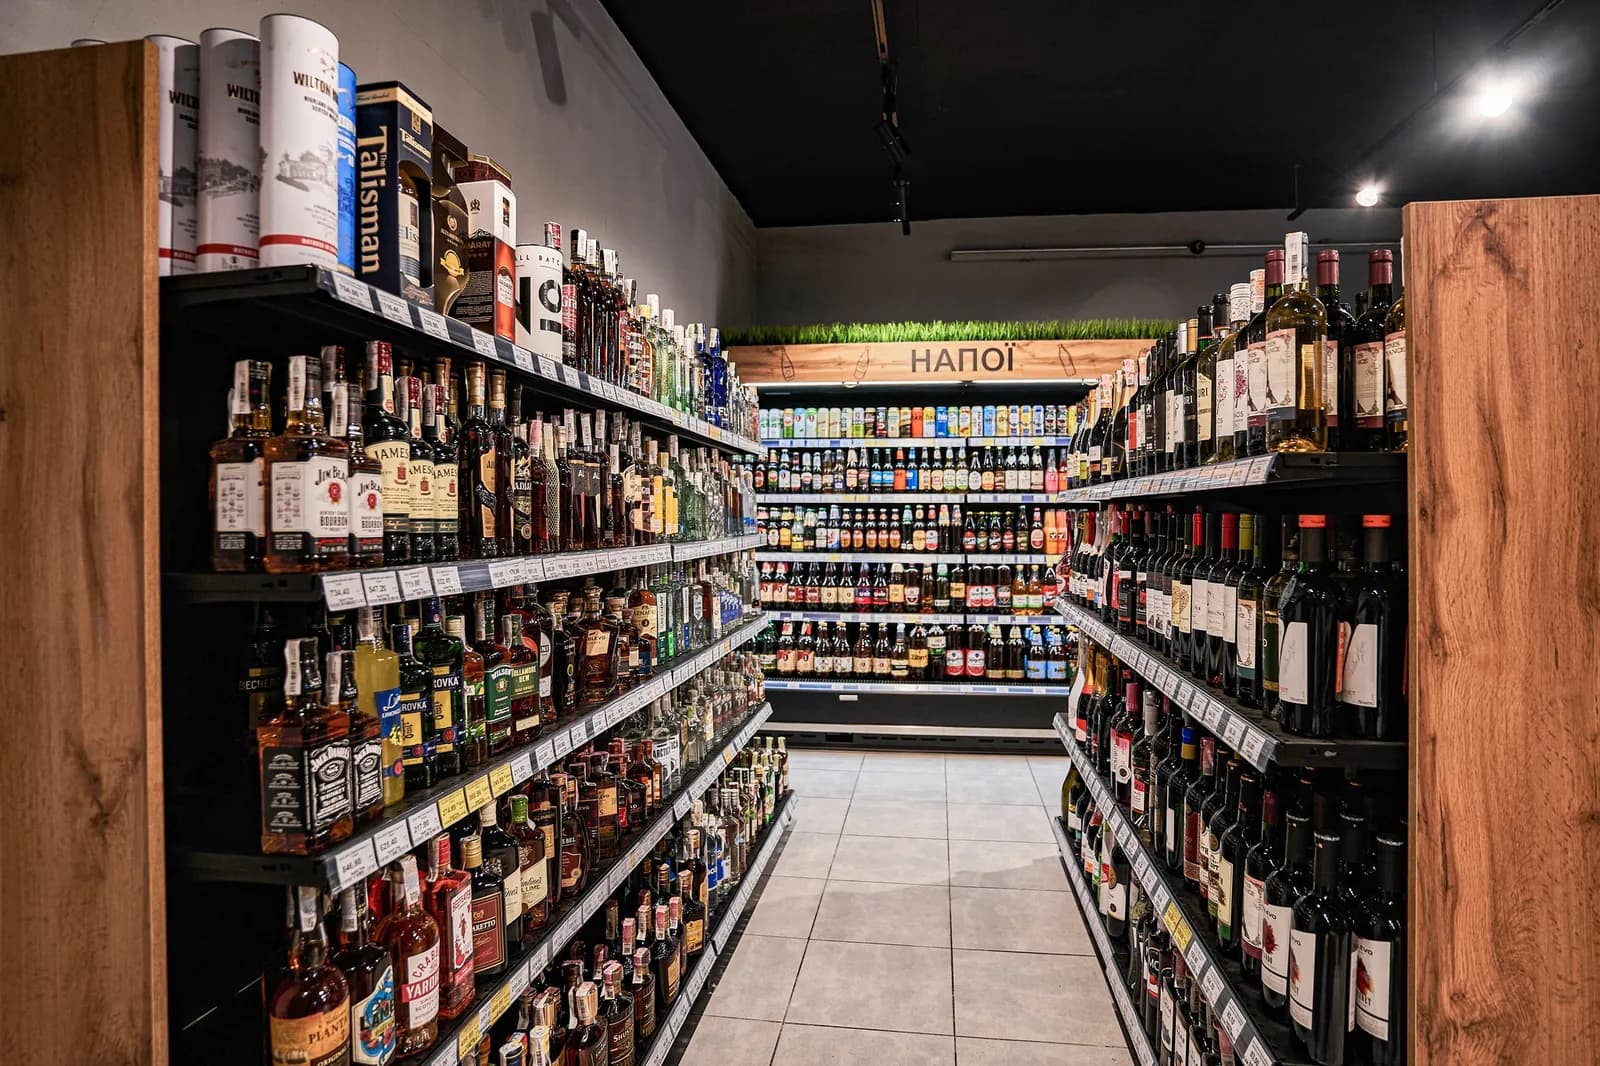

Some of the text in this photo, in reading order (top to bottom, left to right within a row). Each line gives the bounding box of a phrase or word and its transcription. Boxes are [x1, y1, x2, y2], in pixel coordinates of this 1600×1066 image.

[292, 71, 331, 96] WILTON
[357, 125, 388, 274] Talisman
[911, 342, 1014, 374] НАПОЇ
[315, 468, 331, 486] JIM
[319, 516, 349, 527] BOURBON
[401, 700, 427, 712] ROVKA
